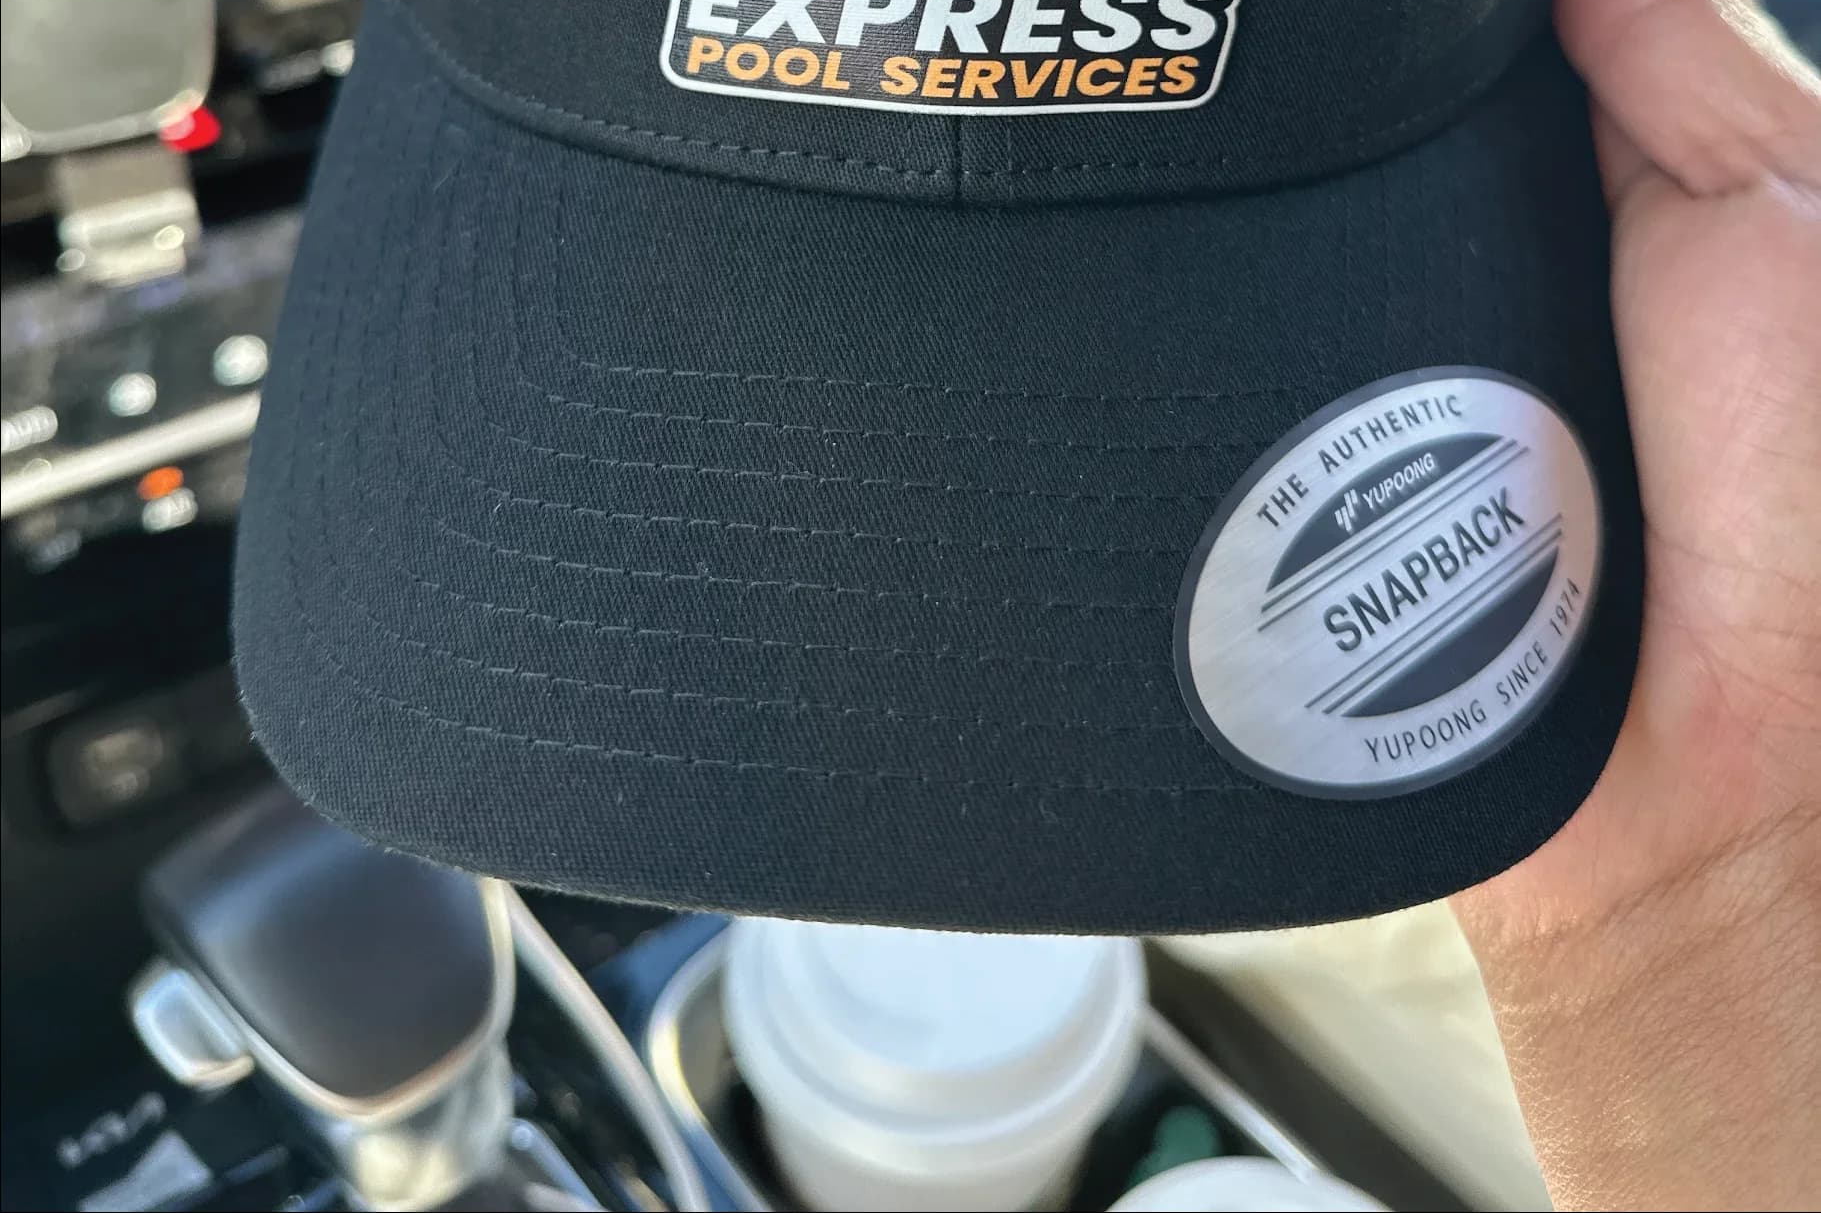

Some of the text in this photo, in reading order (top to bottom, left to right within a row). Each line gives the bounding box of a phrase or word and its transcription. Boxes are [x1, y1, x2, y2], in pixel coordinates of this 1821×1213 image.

[686, 37, 1200, 100] POOL SERVICES
[1257, 393, 1464, 529] THE AUTHENTIC
[1361, 452, 1437, 514] YUPOONG
[1323, 486, 1526, 653] SNAPBACK
[1364, 577, 1580, 763] YUPOONG SINCE 1974
